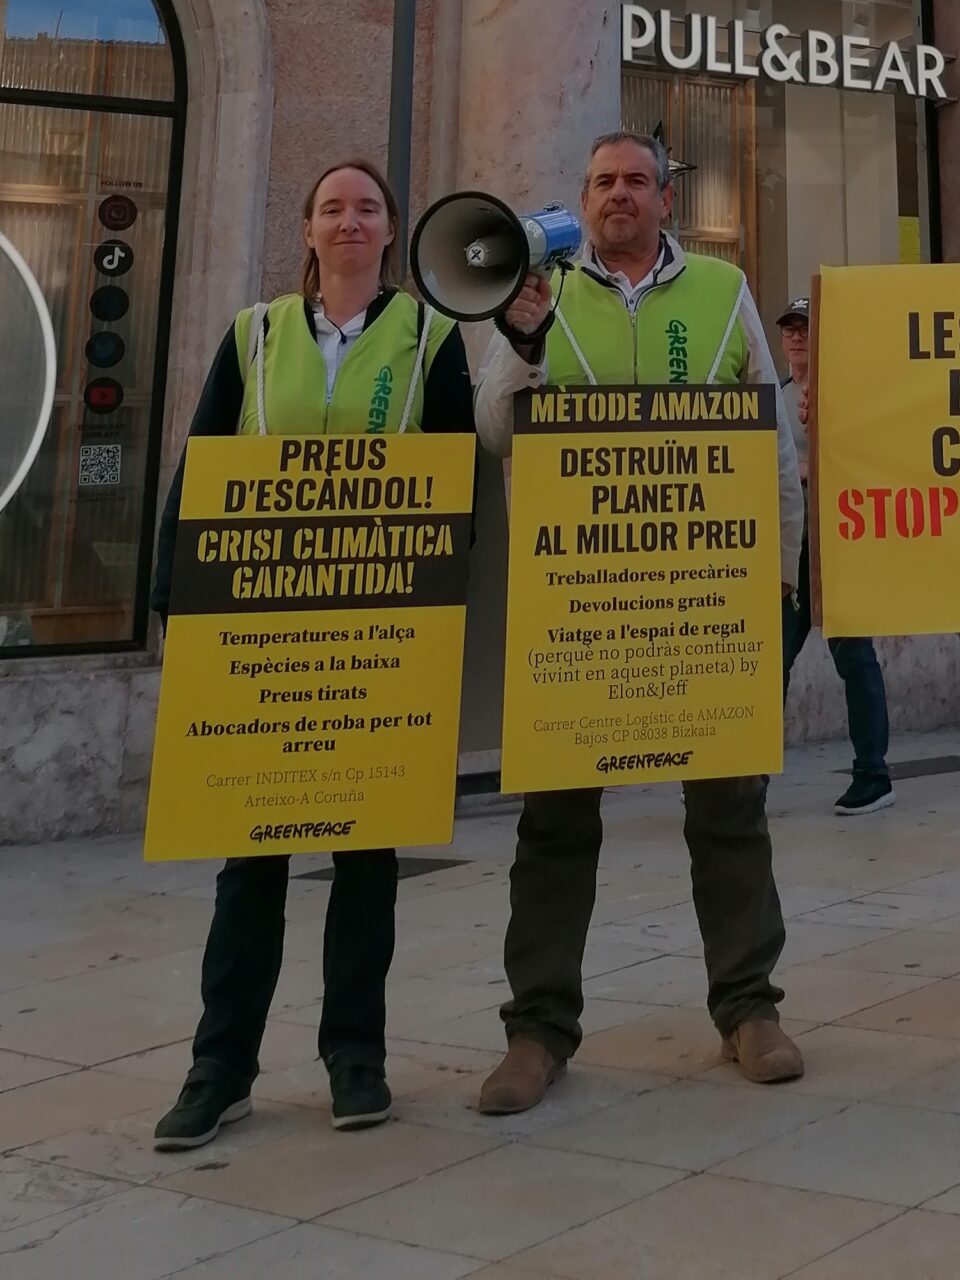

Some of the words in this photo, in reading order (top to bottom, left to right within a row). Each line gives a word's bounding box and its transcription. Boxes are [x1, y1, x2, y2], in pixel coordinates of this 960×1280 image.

[621, 4, 948, 98] PULL&BEAR
[531, 385, 641, 423] MÈTODE
[650, 392, 758, 420] AMAZON
[279, 438, 386, 472] PREUS
[561, 440, 697, 477] DESTRUÏM
[707, 446, 734, 473] EL
[224, 467, 433, 512] D'ESCÀNDOL!
[592, 483, 705, 514] PLANETA
[838, 487, 958, 540] STOP
[198, 529, 282, 562] CRISI
[293, 517, 453, 559] CLIMÀTICA
[535, 525, 567, 556] AL
[577, 522, 677, 554] MILLOR
[688, 519, 756, 550] PREU
[232, 562, 414, 598] GARANTIDA!
[546, 568, 665, 585] Treballadores
[670, 564, 747, 584] precàries
[569, 595, 674, 613] Devolucions
[678, 592, 725, 612] gratis
[219, 630, 349, 649] Temperatures
[354, 630, 363, 640] a
[368, 624, 415, 643] l'alça
[547, 627, 602, 645] Viatge
[607, 629, 615, 640] a
[620, 622, 673, 639] l'espai
[679, 622, 699, 636] de
[703, 620, 745, 637] regal
[230, 657, 310, 678] Espècies
[315, 661, 325, 672] a
[330, 656, 345, 670] la
[351, 654, 400, 669] baixa
[527, 647, 593, 668] (perquè
[599, 649, 620, 660] no
[625, 641, 680, 663] podràs
[685, 641, 763, 655] continuar
[533, 667, 580, 684] vivint
[585, 669, 605, 680] en
[611, 664, 664, 683] aquest
[669, 658, 735, 680] planeta)
[740, 657, 758, 676] by
[260, 689, 312, 704] Preus
[318, 685, 367, 701] tirats
[609, 679, 688, 700] Elon&Jeff
[186, 719, 290, 736] Abocadors
[295, 716, 317, 732] de
[322, 715, 365, 731] roba
[370, 716, 402, 732] per
[407, 712, 431, 726] tot
[534, 720, 580, 731] Carrer
[578, 716, 622, 729] Centre
[626, 712, 676, 729] Logístic
[678, 709, 693, 723] de
[697, 706, 754, 722] AMAZON
[283, 740, 335, 753] arreu
[575, 732, 609, 748] Bajos
[611, 729, 629, 742] CP
[633, 727, 668, 741] 08038
[672, 723, 715, 739] Bizkaia
[596, 751, 693, 773] GREENPEACE
[205, 774, 251, 787] Carrer
[256, 769, 317, 785] INDITEX
[321, 769, 341, 783] s/n
[344, 768, 365, 783] Cp
[369, 764, 405, 779] 15143
[245, 792, 310, 807] Arteixo-A
[314, 789, 365, 804] Coruña
[250, 820, 356, 843] GREENPEACE
